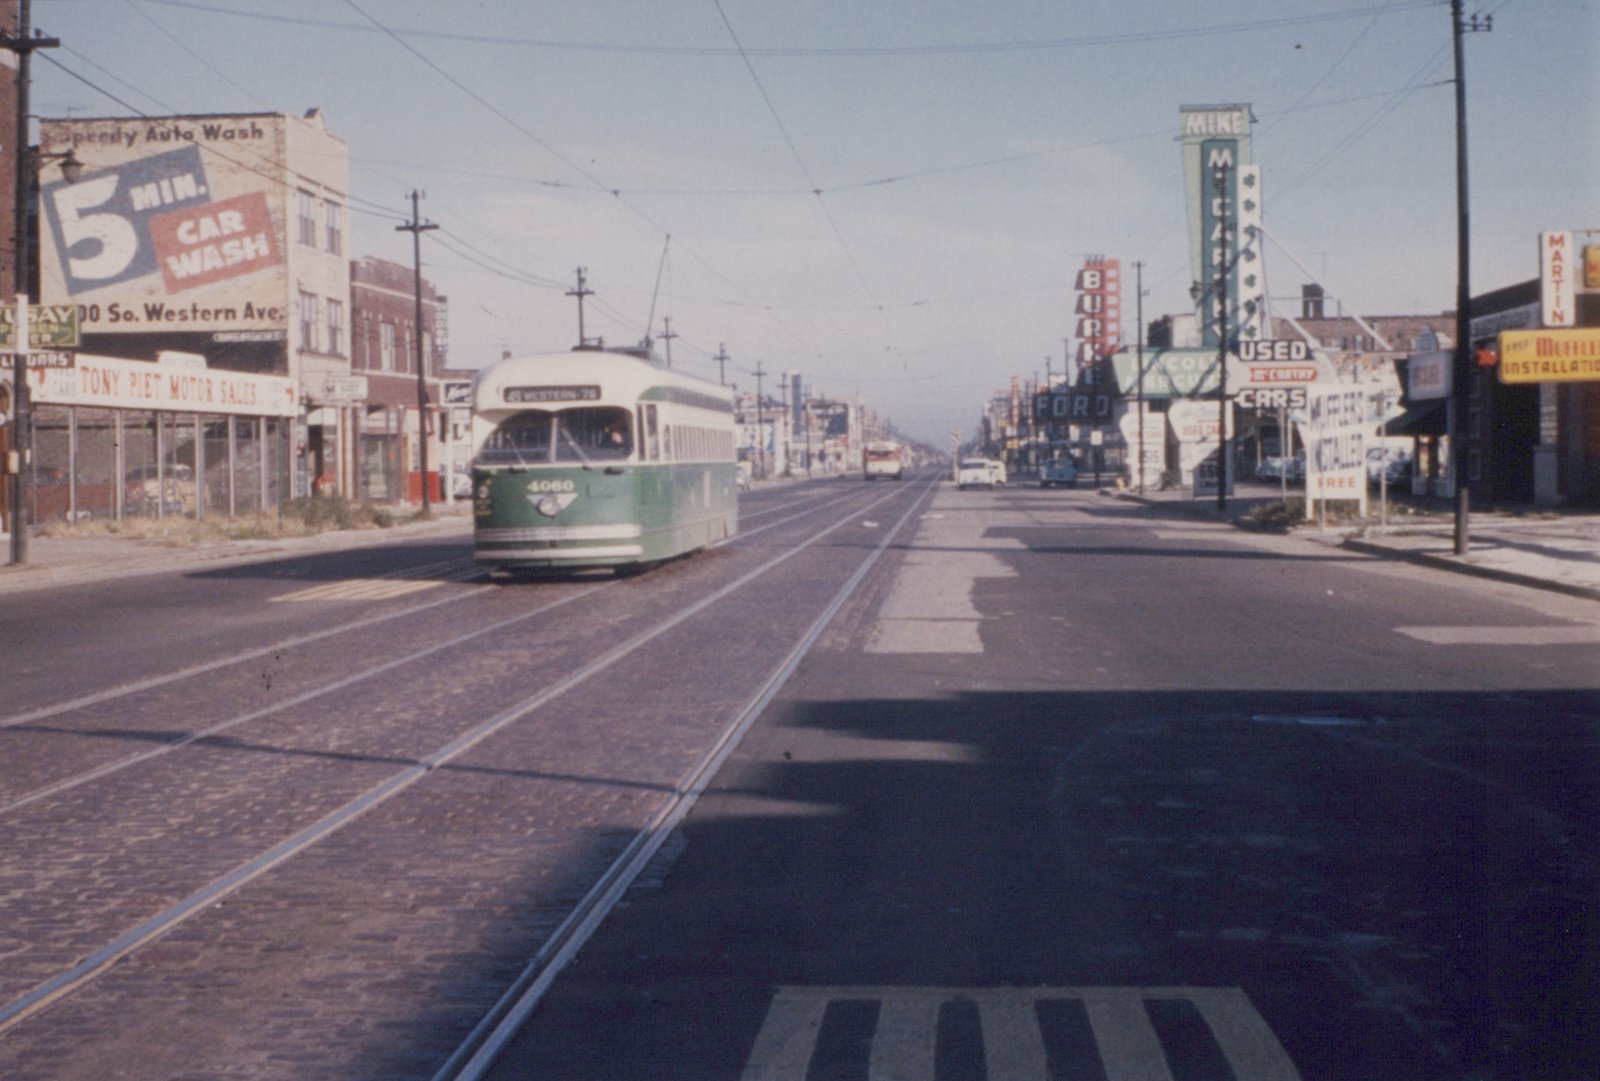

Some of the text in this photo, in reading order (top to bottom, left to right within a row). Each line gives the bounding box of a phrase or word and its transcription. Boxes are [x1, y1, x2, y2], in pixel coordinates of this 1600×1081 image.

[146, 124, 194, 142] Auto
[203, 122, 263, 140] Wash
[1184, 112, 1244, 135] MIKE
[129, 172, 208, 212] MIN.
[52, 173, 140, 280] 5
[177, 209, 246, 247] CAR
[165, 230, 271, 280] WASH
[1549, 234, 1564, 324] MARTIN
[108, 302, 140, 324] So.
[144, 300, 237, 323] Western
[243, 302, 285, 321] Ave.
[1240, 341, 1306, 361] USED
[1536, 337, 1600, 357] MUFFLE
[1, 353, 69, 367] LIUORS
[81, 366, 120, 396] TONY
[130, 372, 161, 400] PIET
[169, 374, 214, 402] MOTOR
[221, 379, 257, 406] SALES
[1036, 395, 1109, 418] FORD
[1239, 388, 1306, 408] CARS
[1317, 477, 1357, 488] FREE
